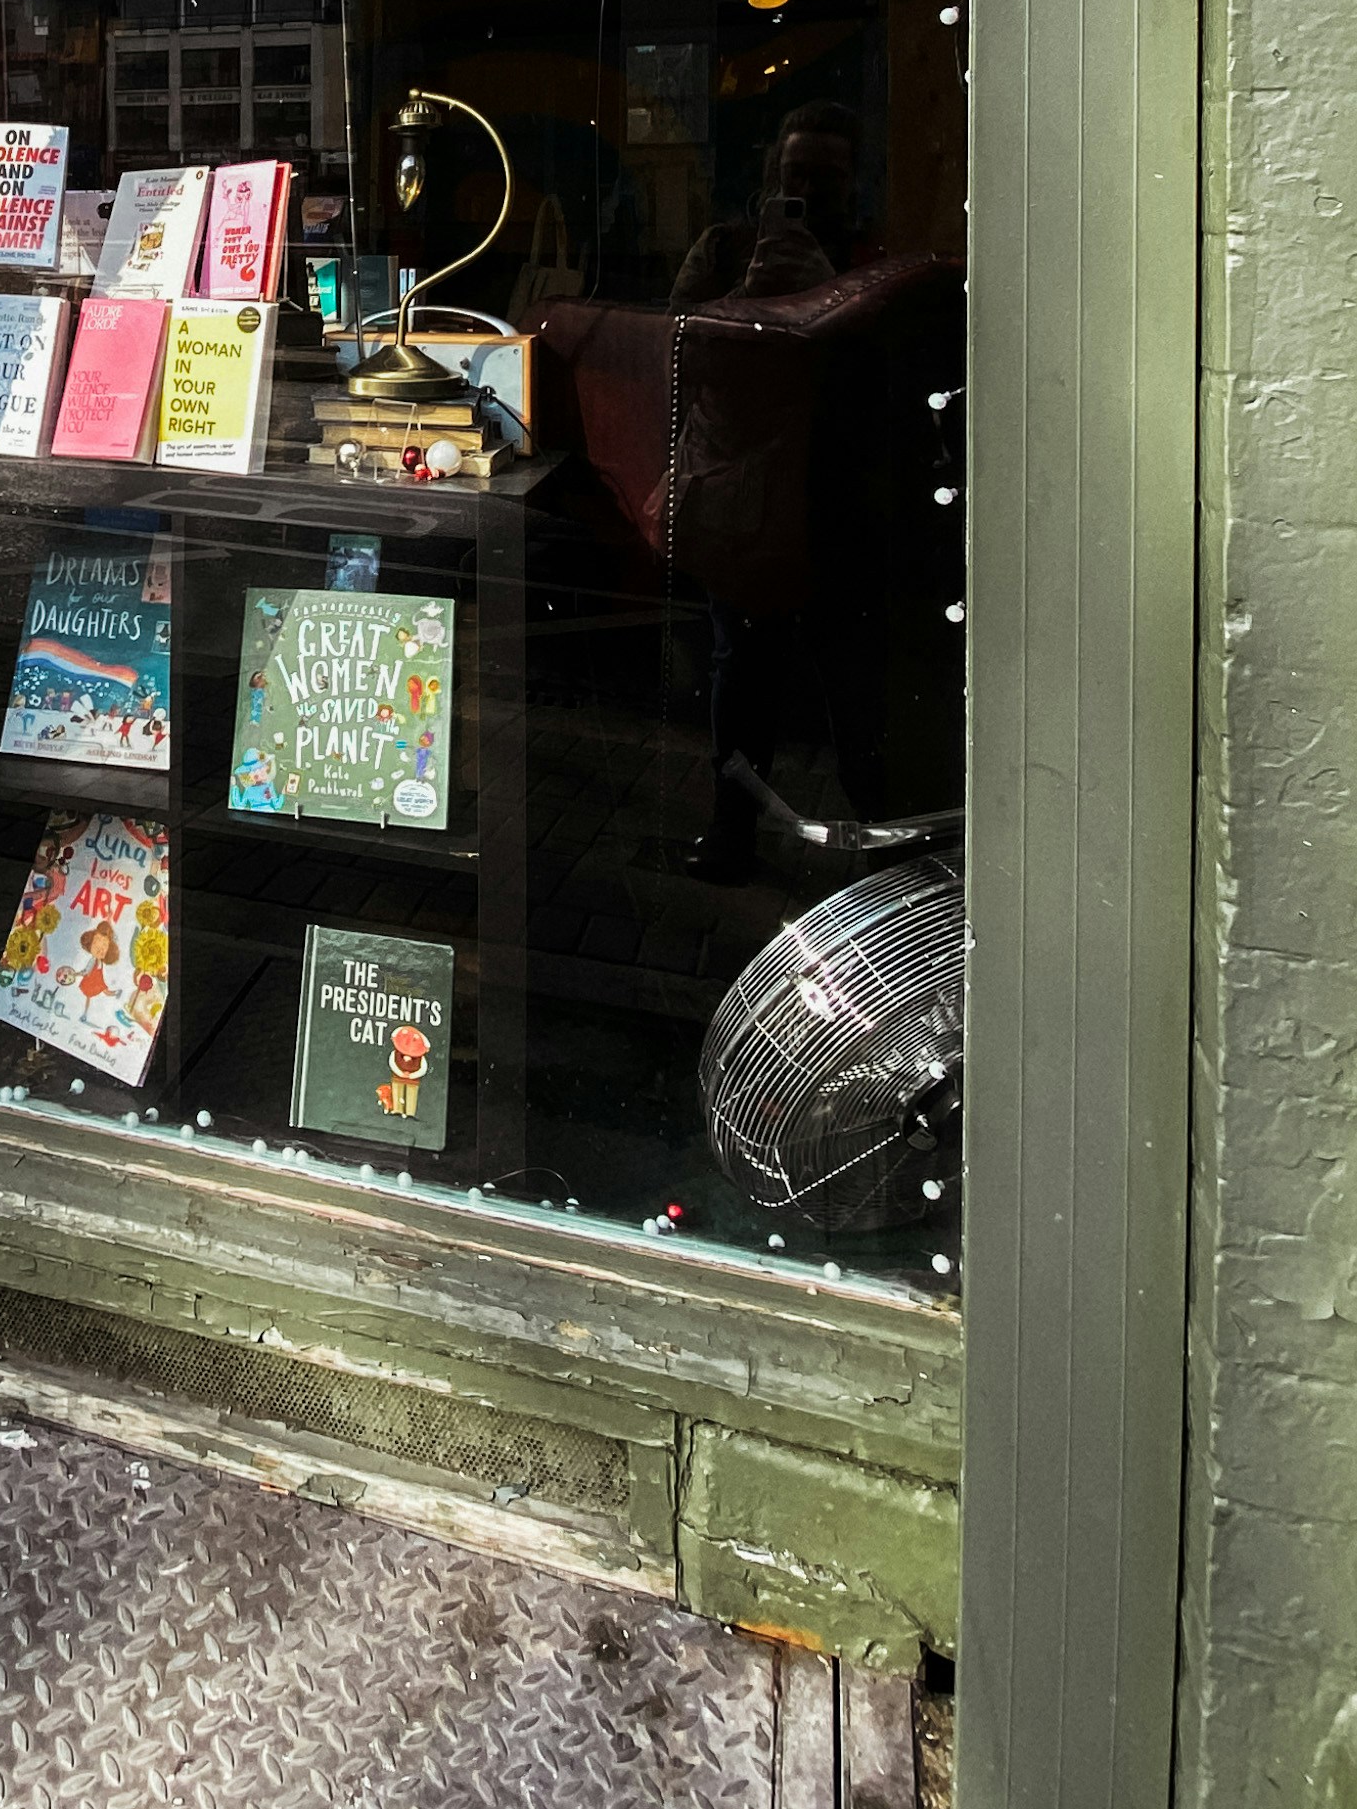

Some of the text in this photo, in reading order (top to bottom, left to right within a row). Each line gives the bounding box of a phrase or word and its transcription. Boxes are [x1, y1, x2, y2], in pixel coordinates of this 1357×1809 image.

[5, 129, 31, 146] ON
[0, 180, 25, 196] ON
[136, 185, 184, 198] Entitled
[225, 225, 252, 236] WOMEN
[222, 240, 260, 254] OWE YOU
[220, 253, 259, 274] PRETTY
[86, 304, 124, 318] AUDRE
[82, 317, 118, 330] LORDE
[178, 320, 189, 335] A
[20, 334, 47, 351] ON
[177, 340, 242, 358] WOMAN
[174, 359, 191, 374] IN
[73, 371, 101, 382] YOUR
[69, 383, 110, 395] SILENCE
[173, 379, 215, 396] YOUR
[67, 395, 118, 408] WILL NOT
[170, 399, 210, 415] OWN
[63, 408, 113, 421] PROTECT
[2, 424, 15, 433] the
[62, 421, 84, 433] YOU
[168, 418, 216, 435] RIGHT
[46, 552, 141, 587] DREAMS
[67, 588, 119, 607] for our
[30, 599, 143, 641] DAUGHTERS
[294, 603, 402, 623] FANTASTICALLY
[298, 619, 391, 661] GREAT
[274, 654, 404, 704] WOMEN
[296, 701, 318, 717] who
[319, 697, 379, 724] SAVED
[296, 726, 394, 770] PLANET
[123, 752, 158, 763] LINDSAY
[323, 764, 350, 780] Kate
[308, 778, 364, 798] Pankhurst
[85, 813, 147, 868] Luna
[90, 857, 133, 890] Loves
[70, 879, 132, 924] ART
[343, 959, 379, 988] THE
[321, 984, 442, 1027] PRESIDENT'S
[350, 1017, 388, 1046] CAT
